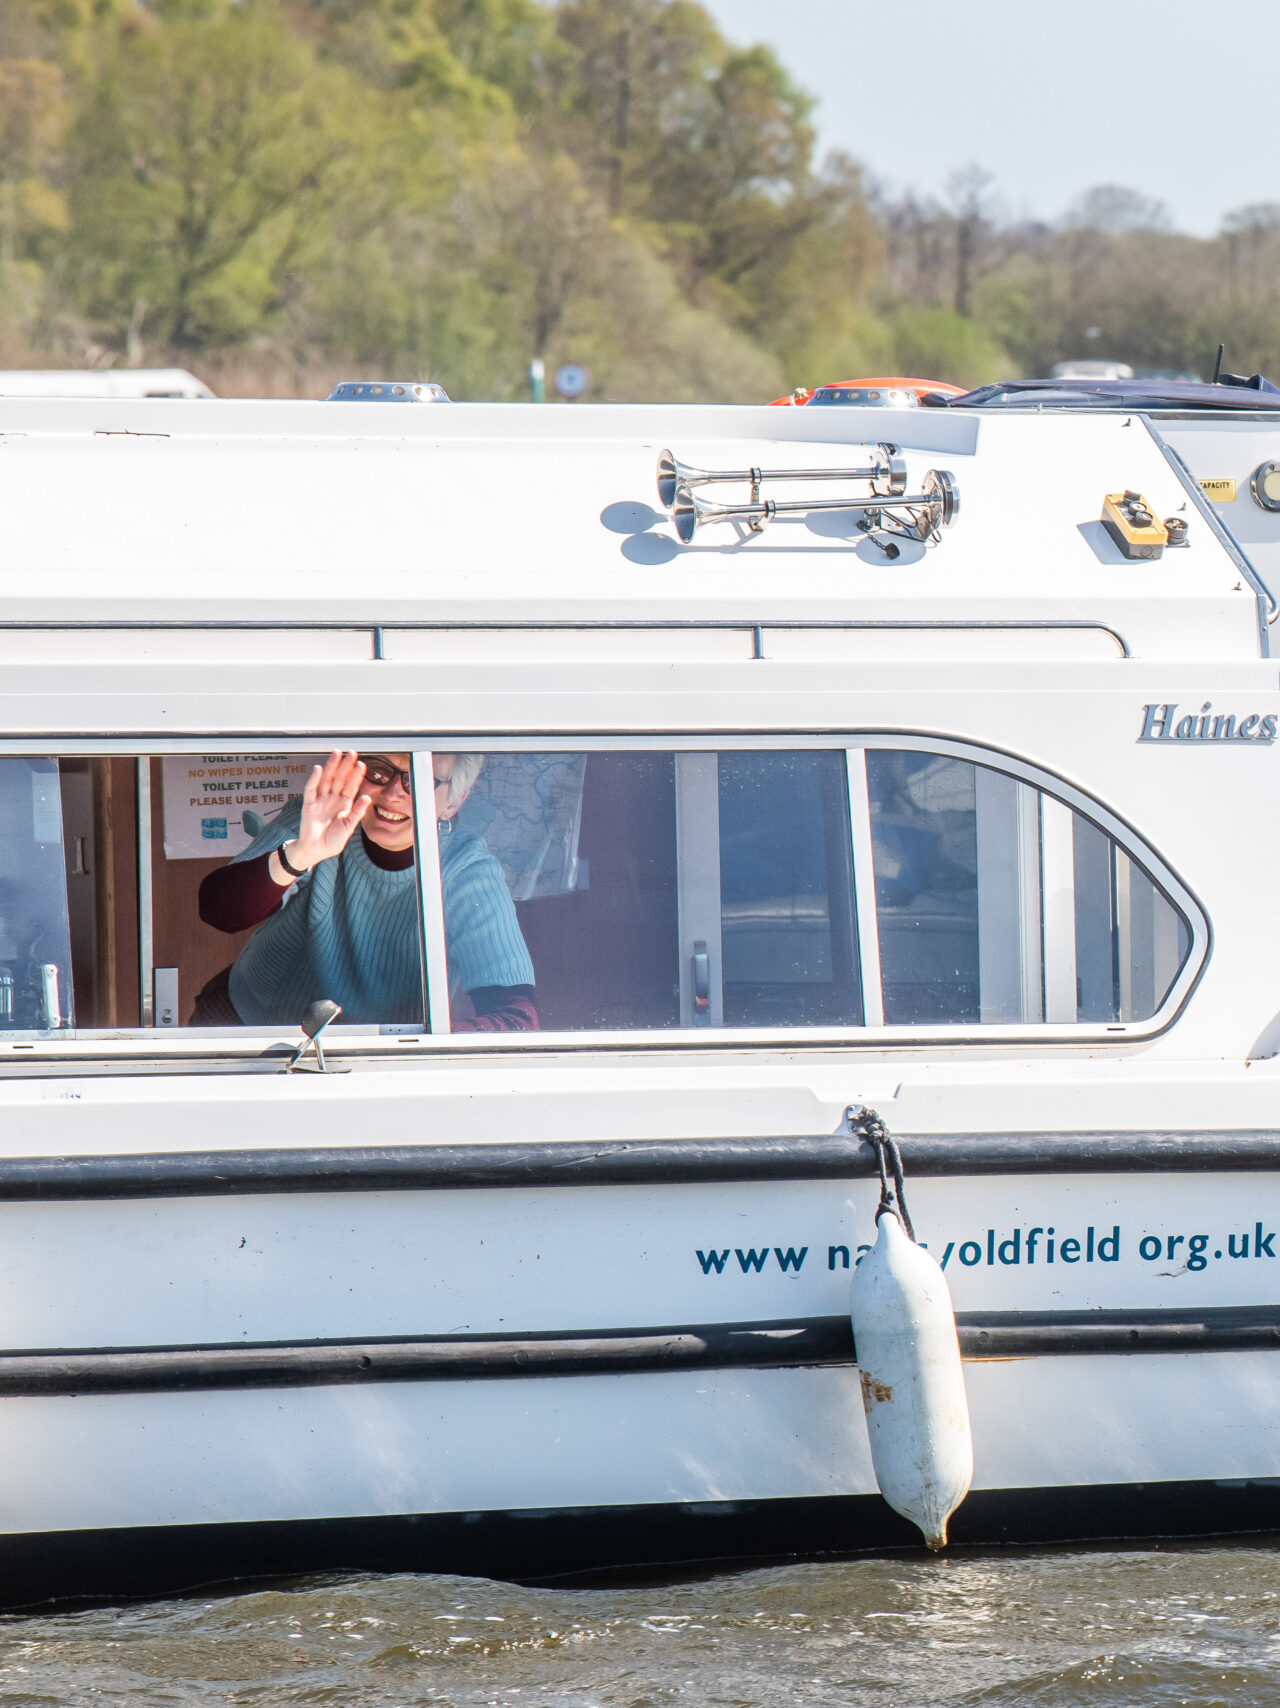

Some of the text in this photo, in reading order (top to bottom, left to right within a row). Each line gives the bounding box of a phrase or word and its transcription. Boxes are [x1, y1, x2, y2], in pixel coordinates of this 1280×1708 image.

[1140, 700, 1279, 739] Haines
[202, 755, 241, 764] TOILET
[188, 764, 307, 779] NO WIPES DOWN THE
[202, 779, 289, 792] TOILET PLEASE
[189, 796, 232, 807] PLEASE
[235, 795, 258, 805] USE
[261, 793, 285, 803] THE
[695, 1246, 809, 1275] www
[1138, 1221, 1277, 1272] org.uk
